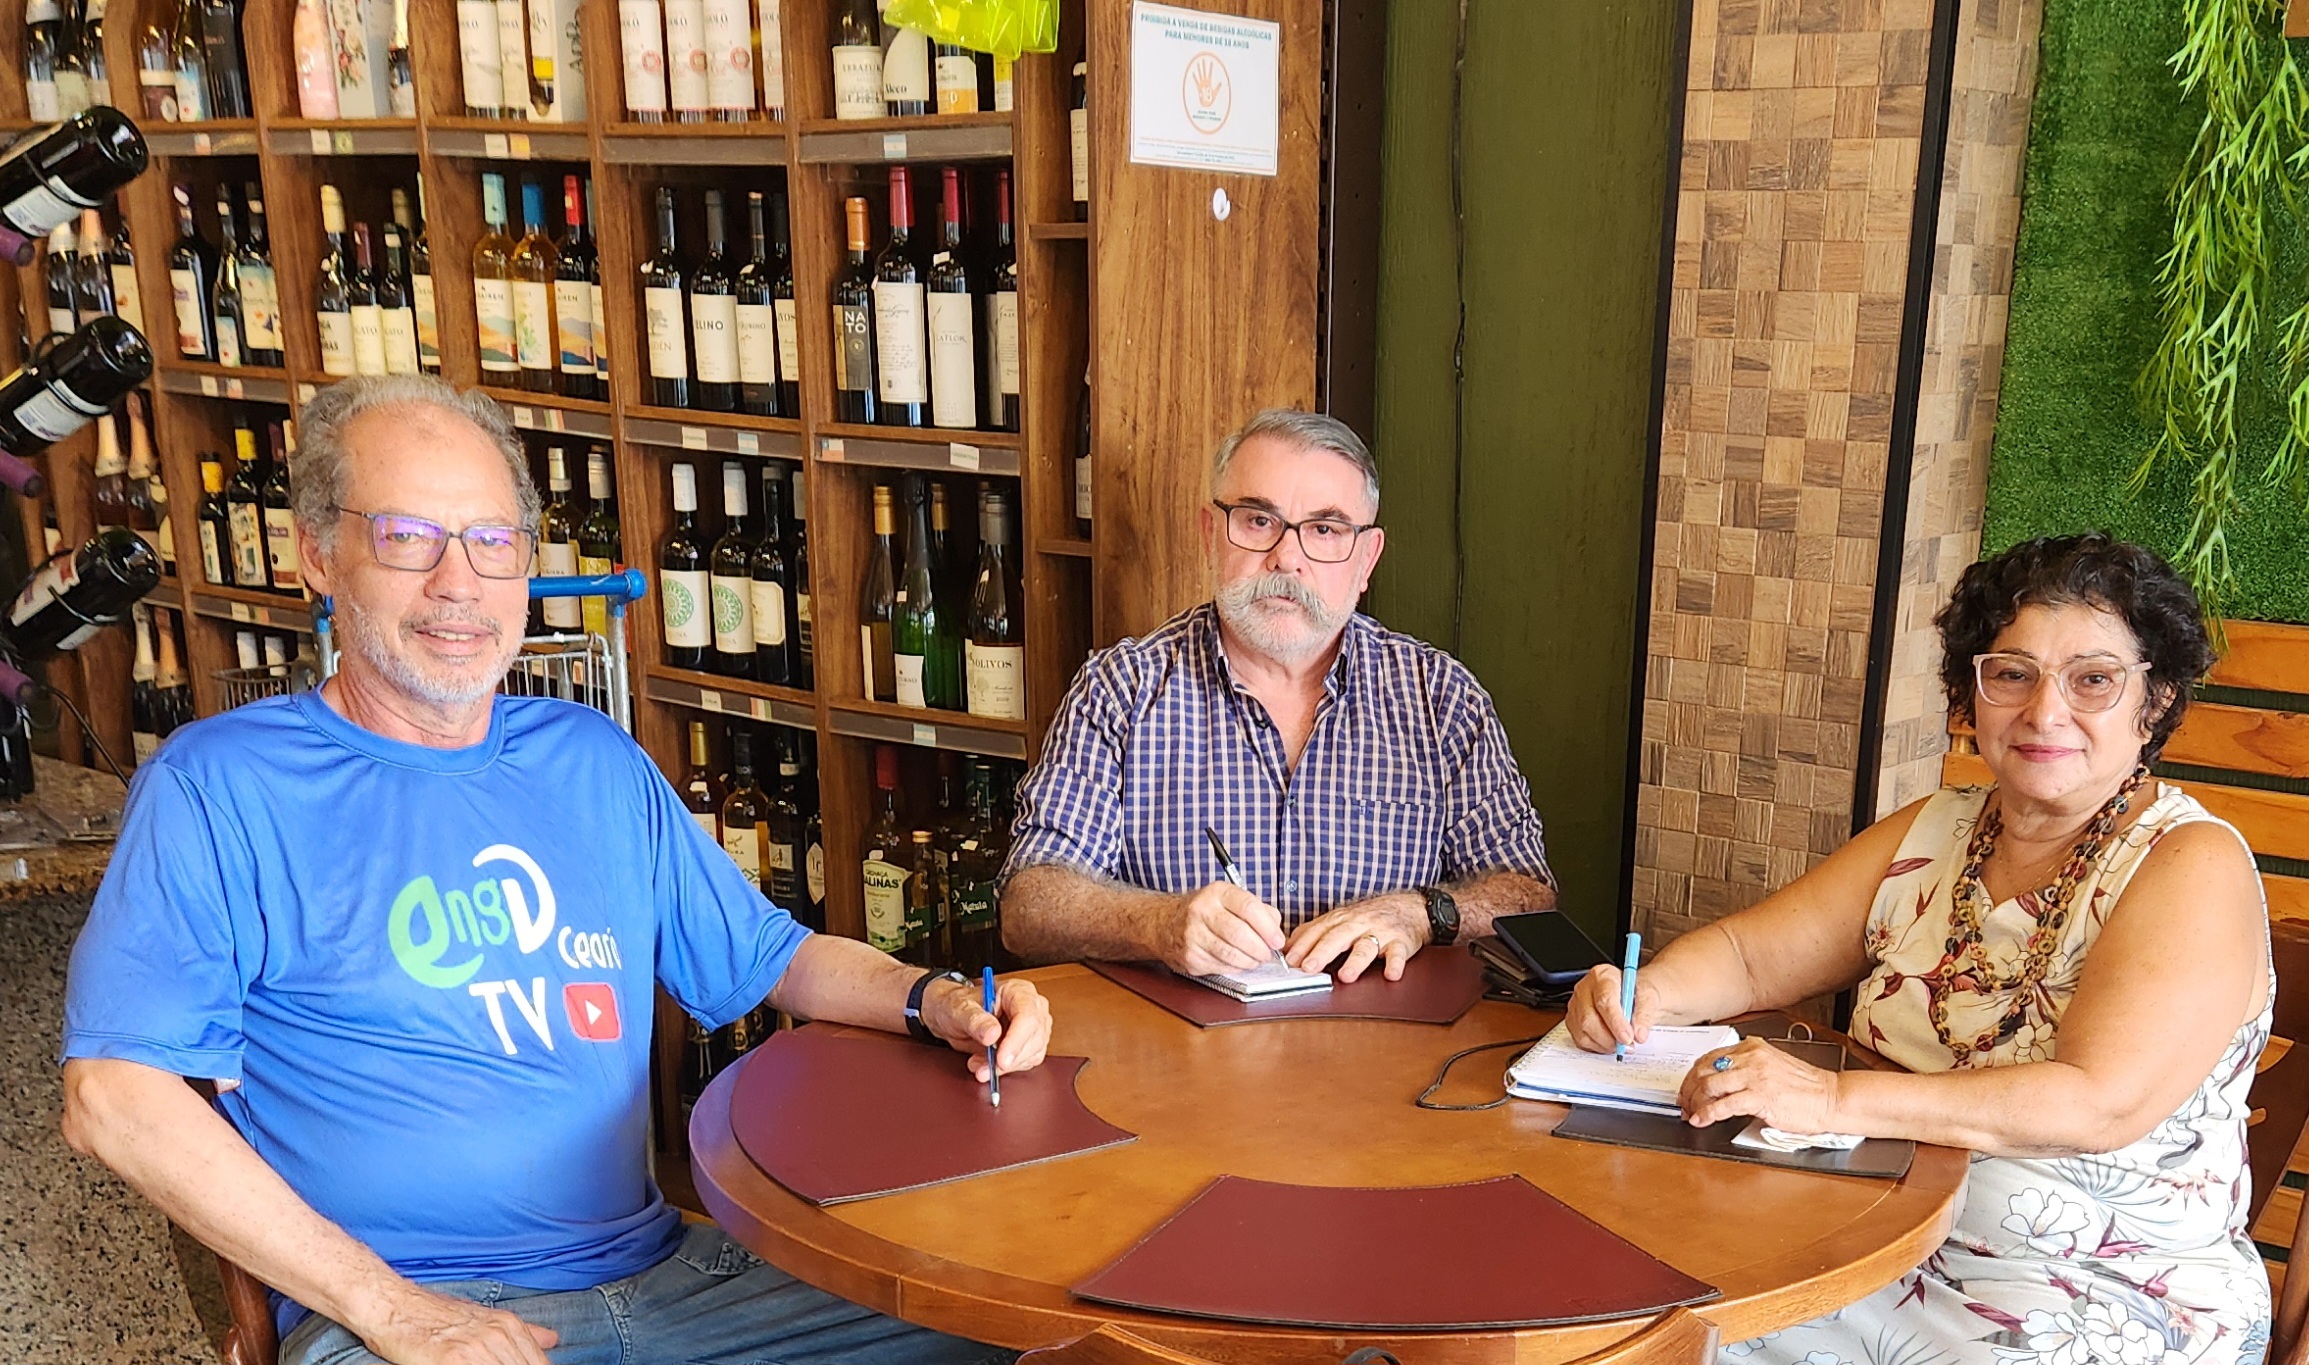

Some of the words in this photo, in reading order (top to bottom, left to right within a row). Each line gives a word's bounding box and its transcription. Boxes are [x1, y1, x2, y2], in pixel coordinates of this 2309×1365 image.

[1177, 19, 1199, 29] VENDA
[1199, 23, 1208, 31] DE
[1209, 24, 1236, 35] BEBIDAS
[1165, 29, 1182, 39] PARA
[1183, 32, 1214, 45] MENORES
[1214, 37, 1223, 46] DE
[1233, 39, 1250, 49] ANOS
[845, 310, 866, 323] NA
[845, 322, 867, 334] TO
[468, 976, 555, 1055] TV
